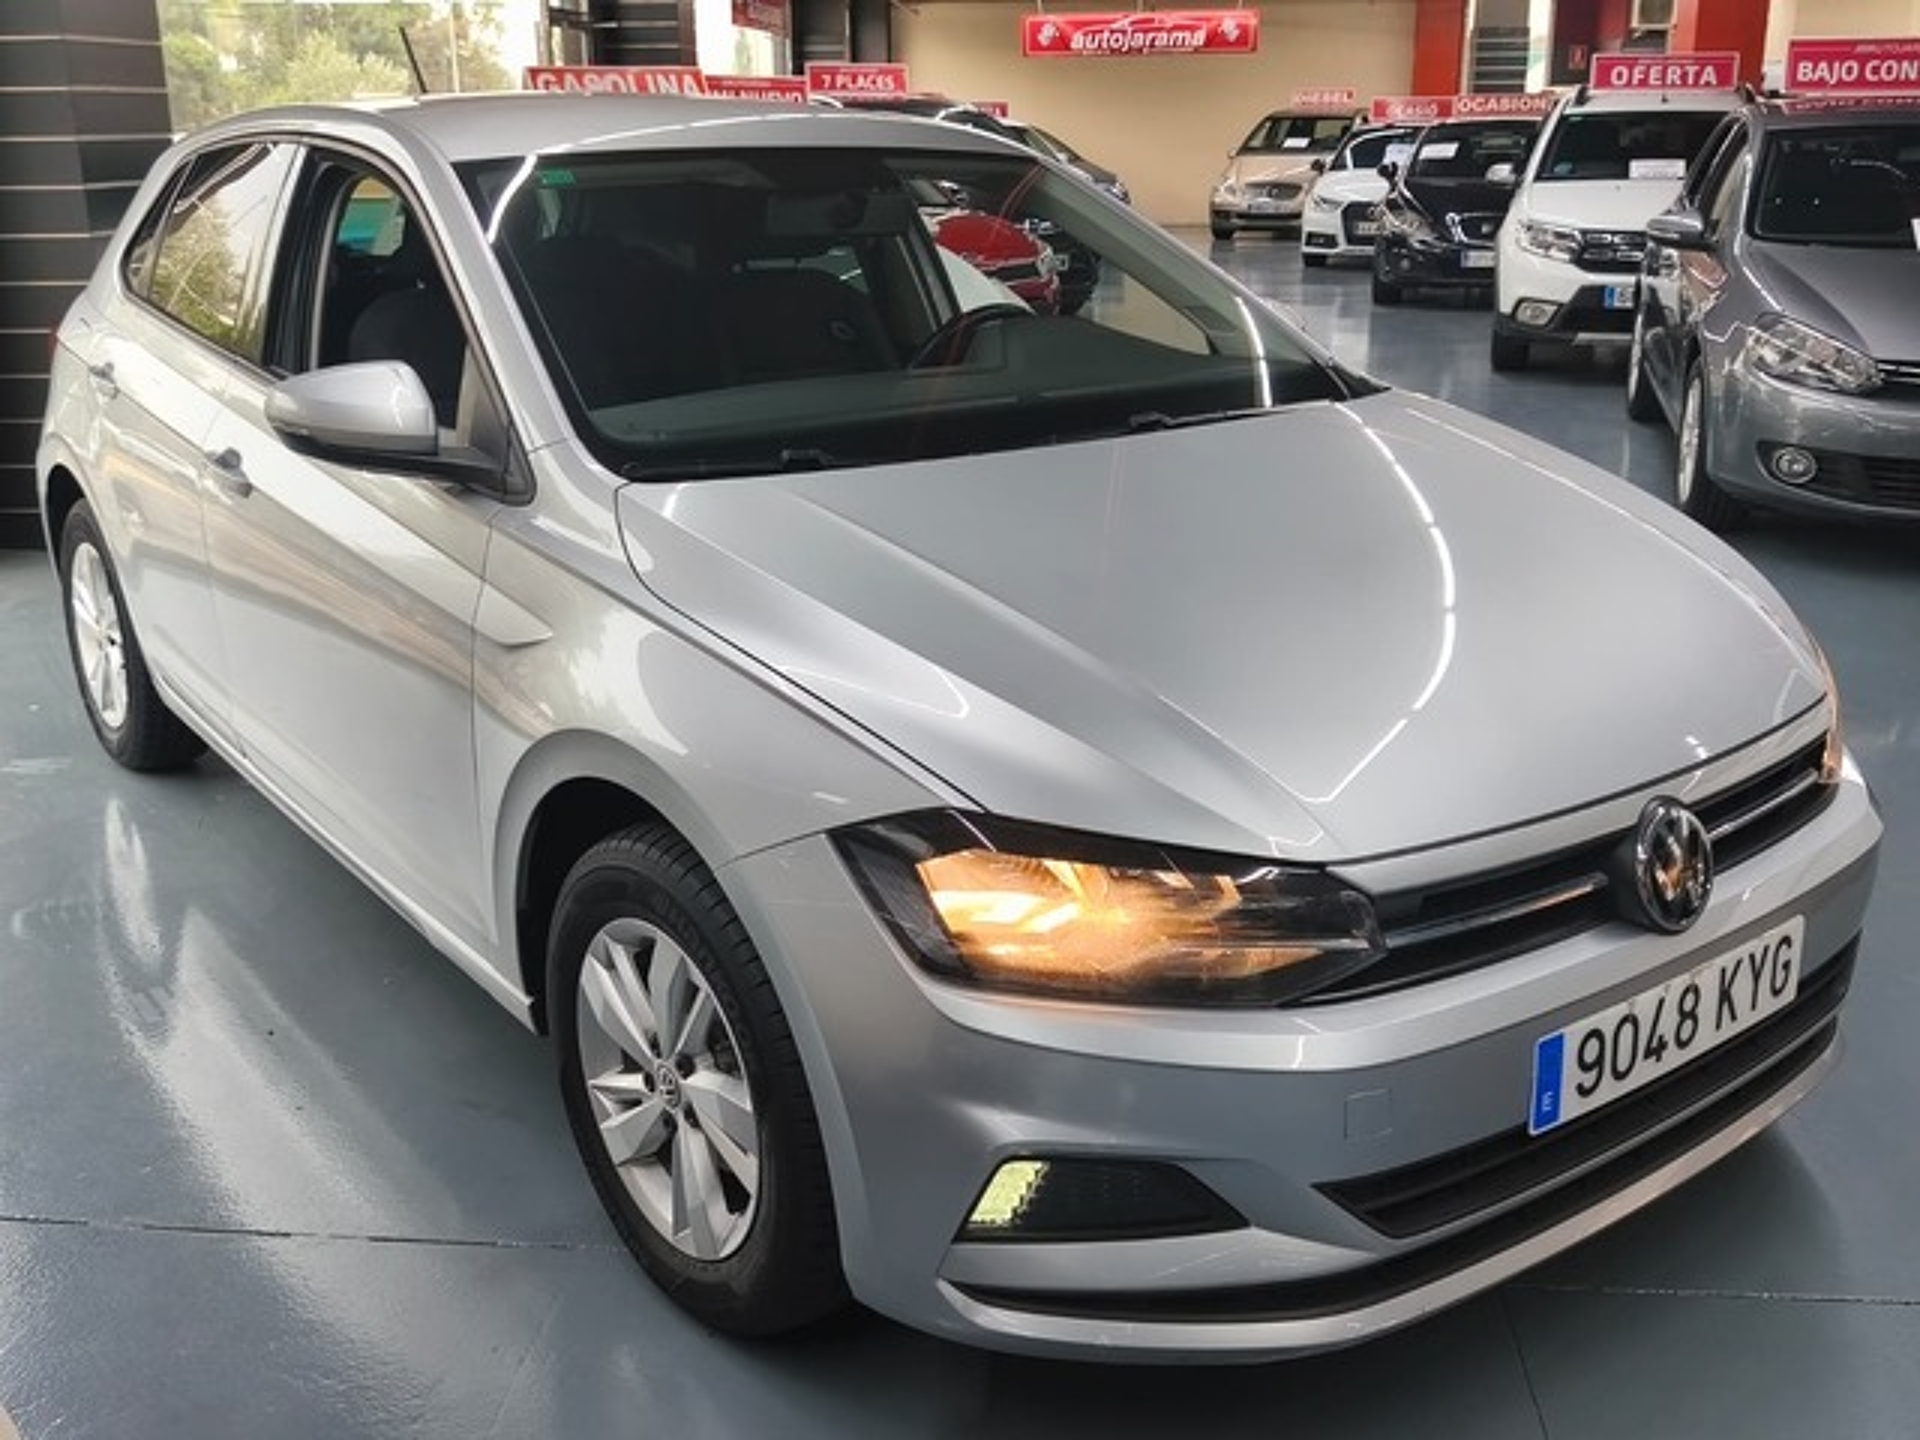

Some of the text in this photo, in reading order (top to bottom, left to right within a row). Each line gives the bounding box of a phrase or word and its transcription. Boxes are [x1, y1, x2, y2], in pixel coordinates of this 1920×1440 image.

[1070, 27, 1206, 52] autojarama
[535, 71, 705, 96] GASOLINA
[821, 74, 896, 90] 7 PLACES
[1610, 64, 1718, 86] OFERTA
[1796, 60, 1858, 85] BAJO
[1575, 934, 1793, 1099] 9048 KYG
